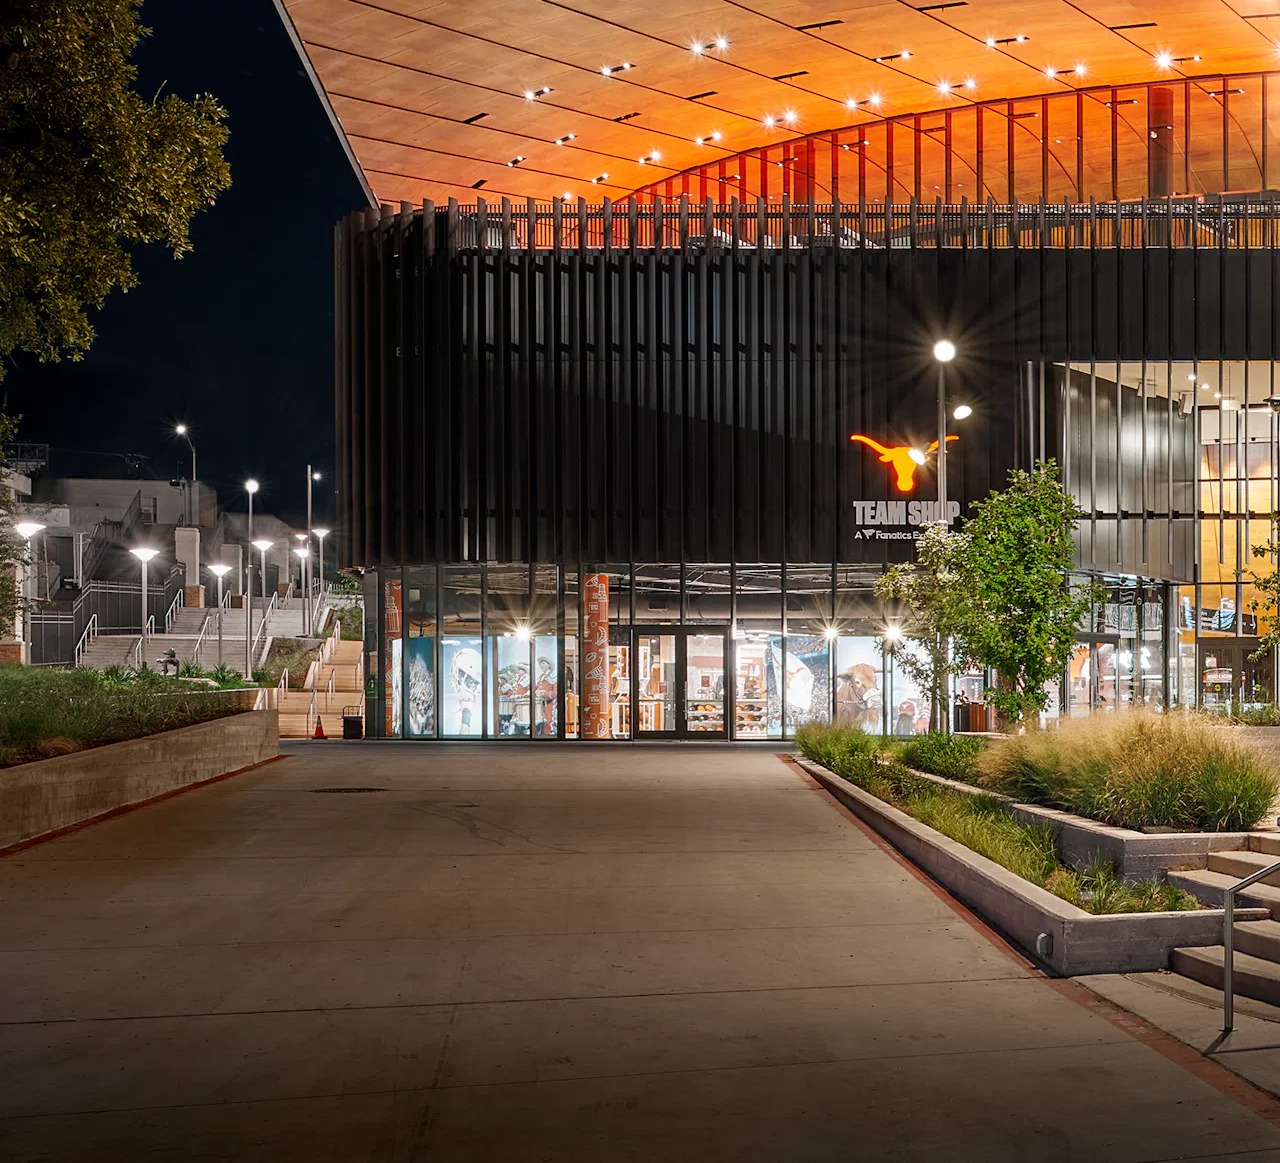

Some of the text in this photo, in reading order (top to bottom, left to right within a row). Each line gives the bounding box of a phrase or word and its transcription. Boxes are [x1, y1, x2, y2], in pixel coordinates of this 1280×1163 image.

[853, 501, 906, 525] TEAM
[854, 531, 862, 539] A
[876, 530, 912, 540] Fanatics
